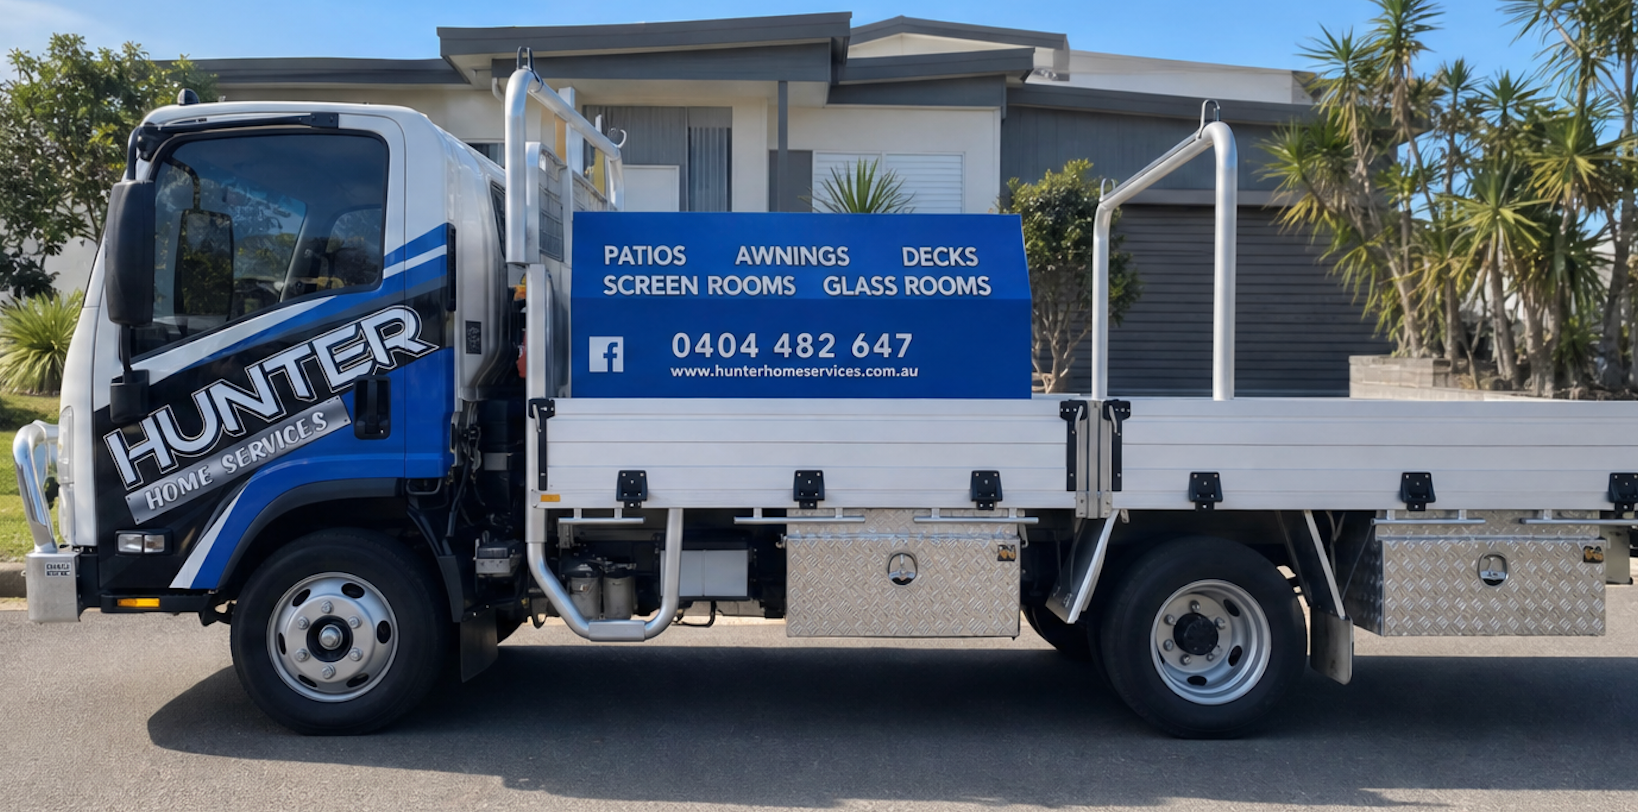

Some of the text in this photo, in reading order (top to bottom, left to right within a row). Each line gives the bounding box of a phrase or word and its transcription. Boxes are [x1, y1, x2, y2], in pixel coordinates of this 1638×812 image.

[604, 245, 979, 267] PATIOS AWNINGS DECKS
[603, 275, 992, 296] SCREEN ROOMS GLASS ROOMS
[671, 332, 914, 359] 0404 482 647
[670, 364, 919, 378] www.hunterhomeservices.com.au
[103, 305, 440, 490] HUNTER
[145, 411, 328, 510] HOME SERVICES
